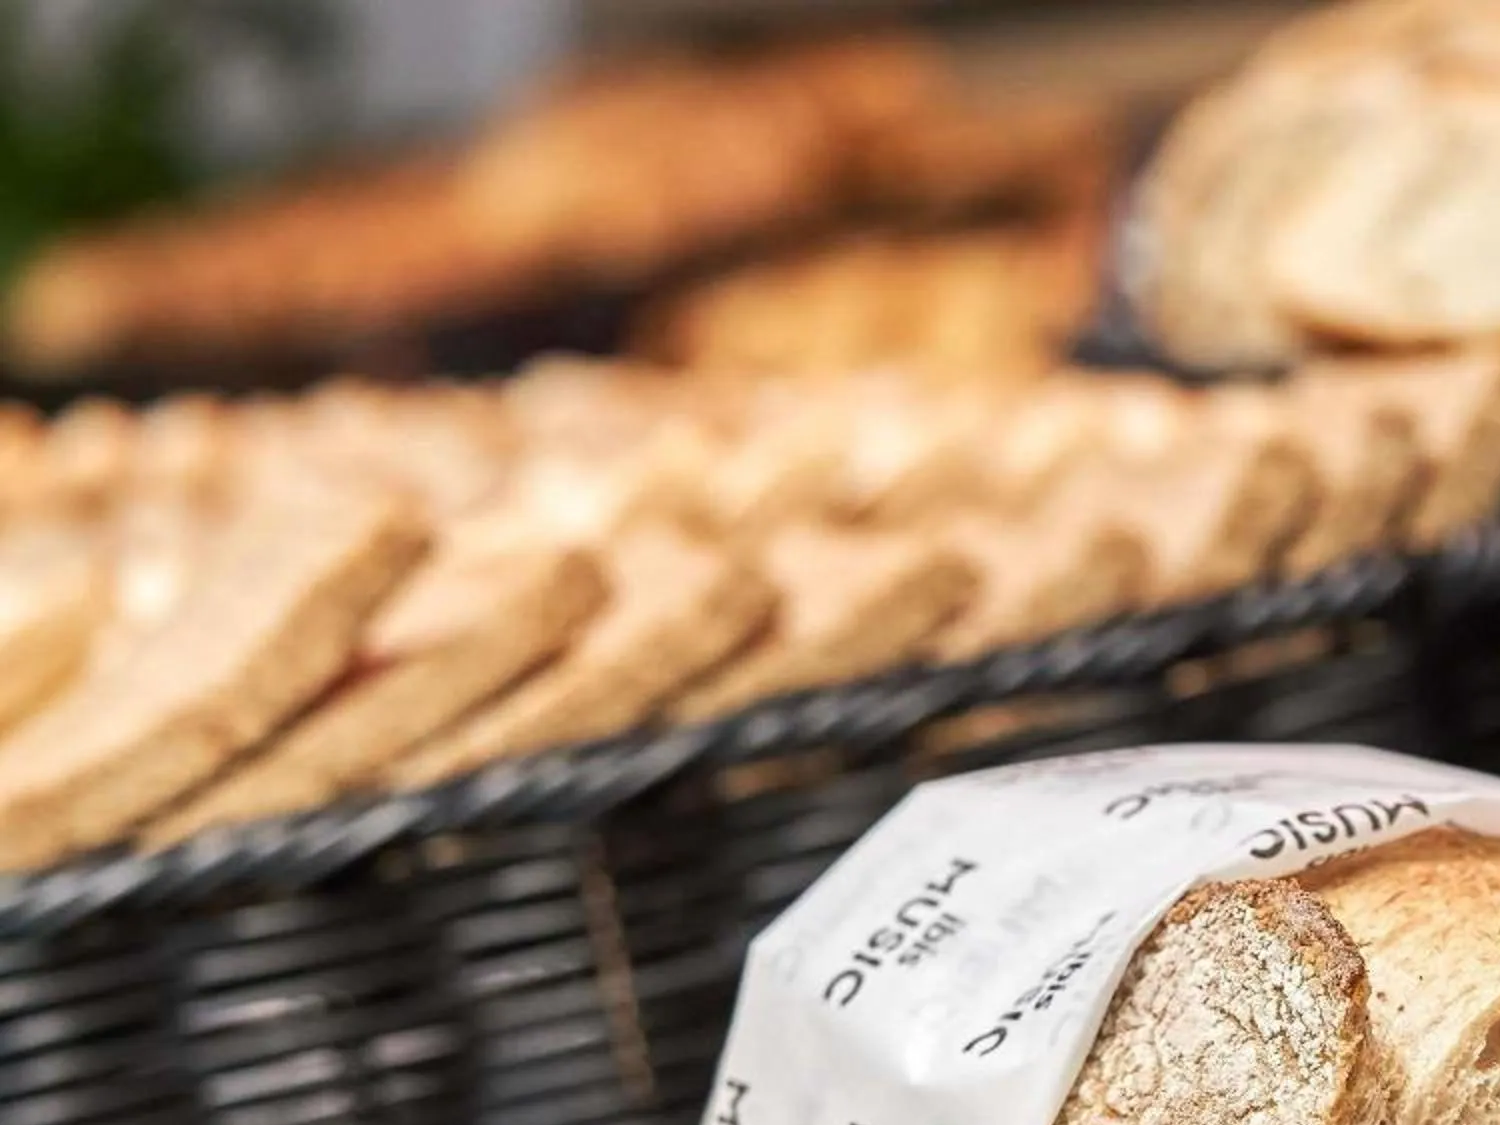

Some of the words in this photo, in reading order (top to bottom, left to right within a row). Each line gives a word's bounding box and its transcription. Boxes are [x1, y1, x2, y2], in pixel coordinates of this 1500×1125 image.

[1249, 794, 1430, 859] MUSIC
[824, 859, 977, 1007] MUSIC
[898, 913, 967, 967] ibis
